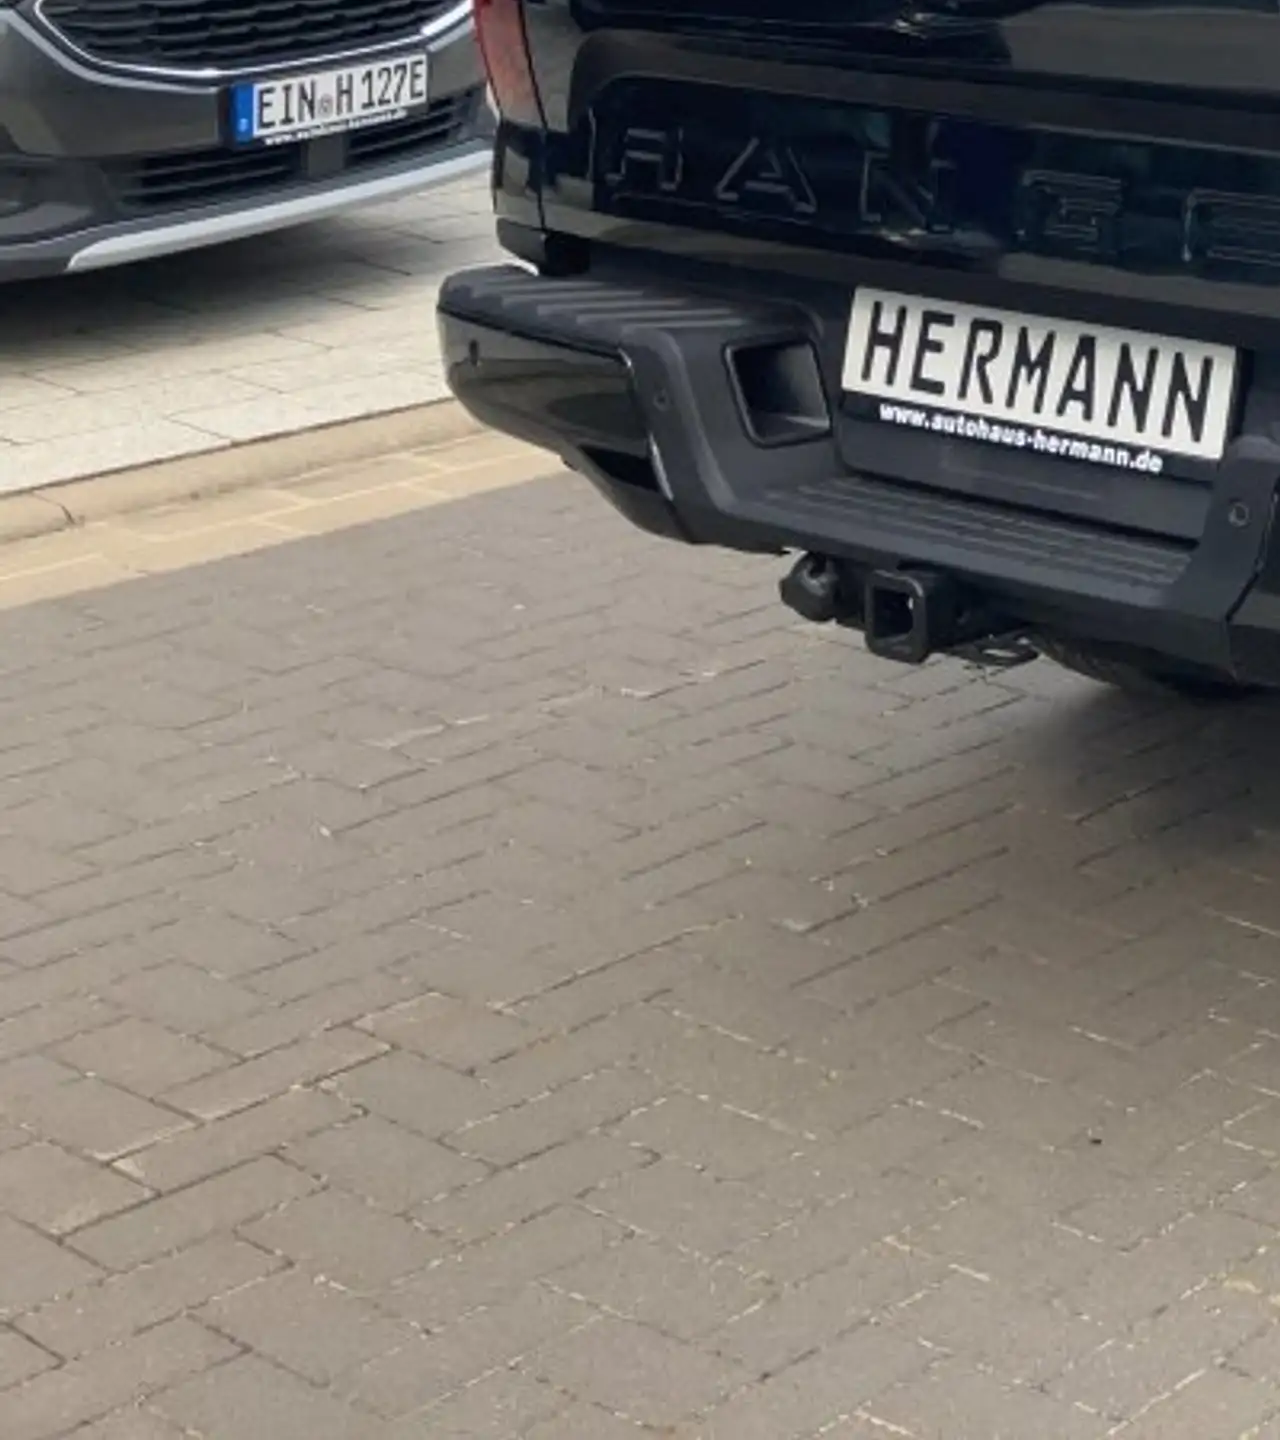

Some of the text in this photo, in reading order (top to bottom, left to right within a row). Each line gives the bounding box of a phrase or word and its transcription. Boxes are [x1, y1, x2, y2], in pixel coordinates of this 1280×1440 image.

[257, 80, 316, 129] EIN
[860, 300, 1214, 444] HERMANN
[879, 402, 1164, 474] www.autohaus-hermann.de
